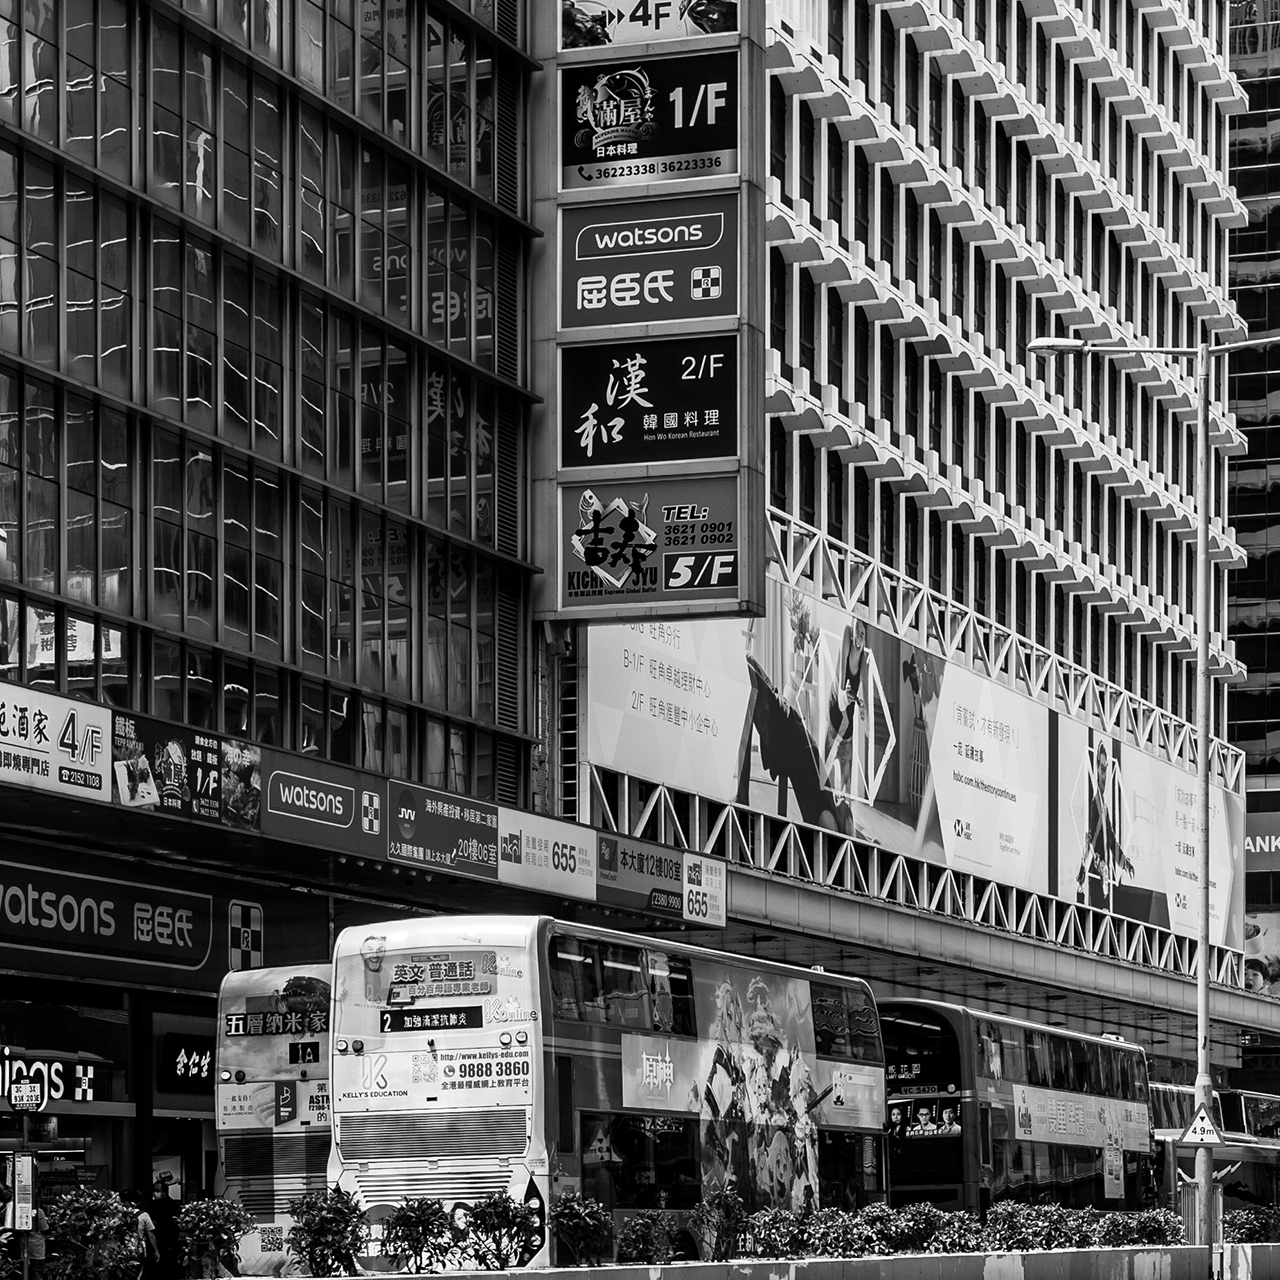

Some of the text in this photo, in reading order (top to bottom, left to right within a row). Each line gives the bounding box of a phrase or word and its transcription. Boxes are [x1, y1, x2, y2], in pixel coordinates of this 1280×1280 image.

[669, 82, 728, 129] 1/F
[596, 142, 638, 158] 日本料理
[595, 156, 722, 180] 36223338 36223336
[595, 219, 703, 250] watsons
[576, 269, 674, 311] 屈臣氏
[681, 354, 724, 380] 2/F
[642, 409, 720, 431] 韓國料理
[643, 433, 657, 441] Hon
[672, 431, 694, 440] Korean
[695, 428, 720, 439] Restaurant
[661, 504, 710, 523] TEL:
[664, 521, 733, 535] 3621 0901
[664, 533, 734, 547] 3621 0902
[668, 555, 735, 588] 5/F
[642, 586, 658, 594] Buffet
[58, 708, 103, 766] 4/F
[70, 773, 100, 788] 2152 1108
[279, 782, 344, 816] watsons
[458, 837, 498, 866] 20樓06室
[552, 841, 577, 874] 655
[620, 849, 682, 882] 本大廈12樓08室
[654, 892, 682, 909] 2380 9900
[687, 889, 708, 918] 655
[133, 901, 193, 948] 屈臣氏
[394, 961, 476, 982] 英文 普通話
[226, 1012, 302, 1036] 五層納米
[383, 1012, 468, 1032] 2 加強清潔抗肺炎
[296, 1043, 315, 1064] 1A
[459, 1061, 530, 1078] 9888 3860
[342, 1090, 408, 1099] KELLY'S EDUCATION
[1191, 1125, 1215, 1137] 4.9m
